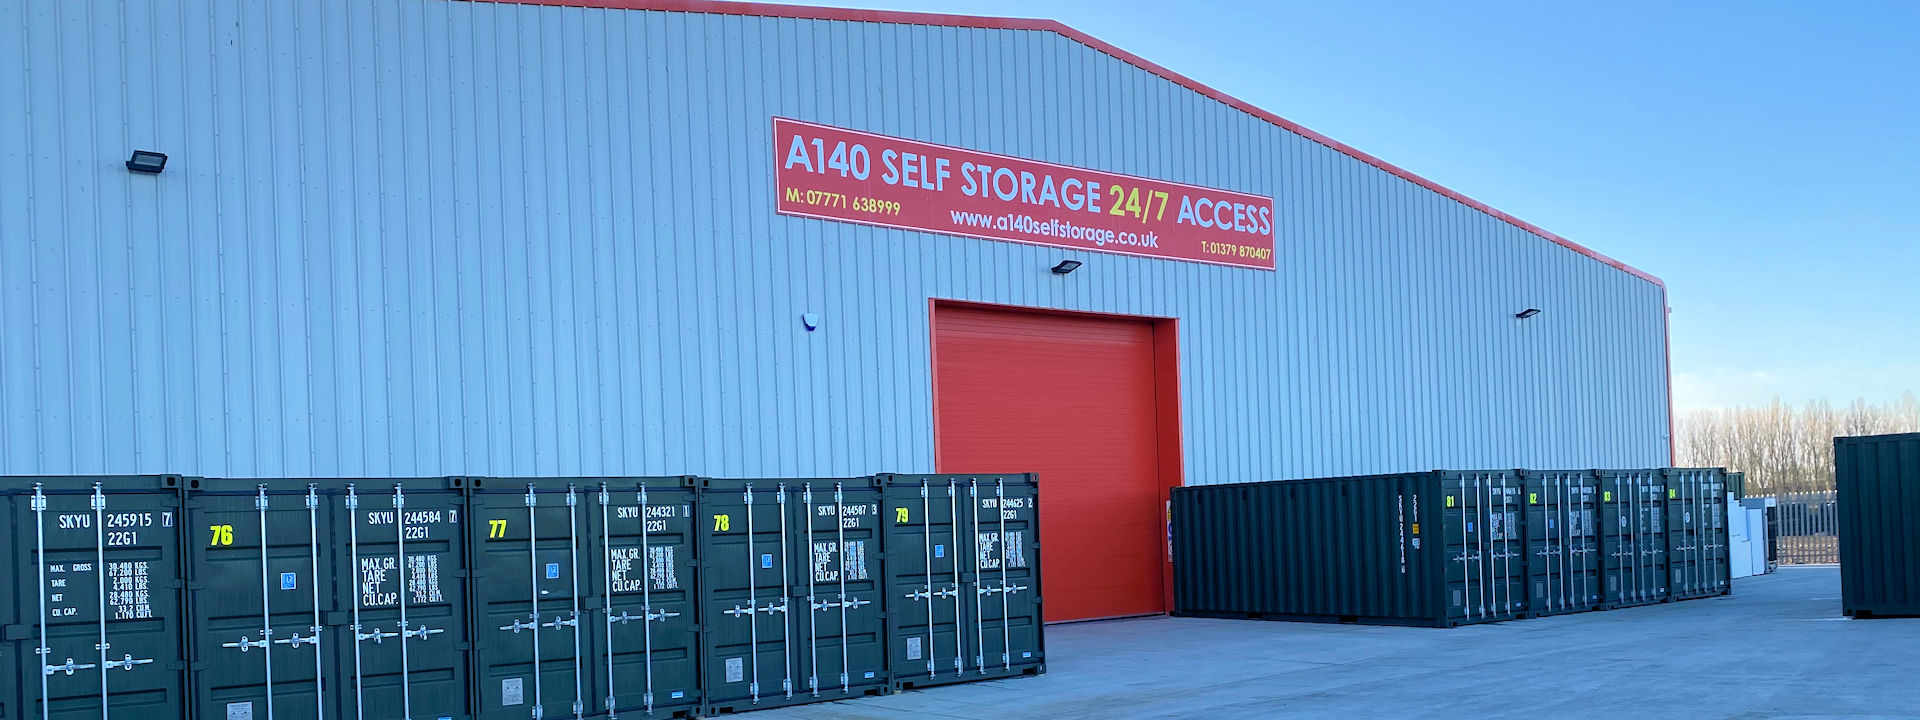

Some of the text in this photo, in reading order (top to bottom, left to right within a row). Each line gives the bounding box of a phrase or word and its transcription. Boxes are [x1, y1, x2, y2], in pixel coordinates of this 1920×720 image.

[785, 134, 1270, 236] A140 SELF STORAGE 24/7 ACCESS
[786, 187, 901, 216] M: 07771 638999
[950, 209, 1158, 249] www.a140selfstorage.co.uk
[1202, 240, 1271, 260] T: 01379 870407
[1446, 496, 1454, 507] 81
[1529, 492, 1537, 504] 82
[1604, 491, 1611, 502] 83
[982, 499, 997, 508] SKYU
[618, 507, 638, 518] SKYU
[646, 506, 675, 518] 244321
[817, 506, 836, 516] SKYU
[842, 504, 866, 516] 244587
[896, 508, 909, 522] 79
[59, 512, 171, 529] SKYU 245915 7
[368, 512, 394, 525] SKYU
[404, 511, 440, 524] 244584
[714, 514, 730, 532] 78
[843, 518, 859, 528] 22G1
[488, 520, 506, 538] 77
[647, 520, 666, 532] 22G1
[108, 531, 137, 545] 22G1
[210, 525, 233, 546] 76
[406, 526, 429, 539] 22G1
[980, 542, 993, 552] TARE
[815, 552, 831, 562] TARE
[980, 551, 990, 560] NET
[73, 563, 92, 572] GROSS
[612, 559, 632, 570] TARE
[815, 562, 827, 572] NET
[362, 570, 386, 582] TARE
[612, 570, 627, 582] NET
[51, 578, 66, 588] TARE
[362, 582, 380, 594] NET
[52, 593, 63, 602] NET
